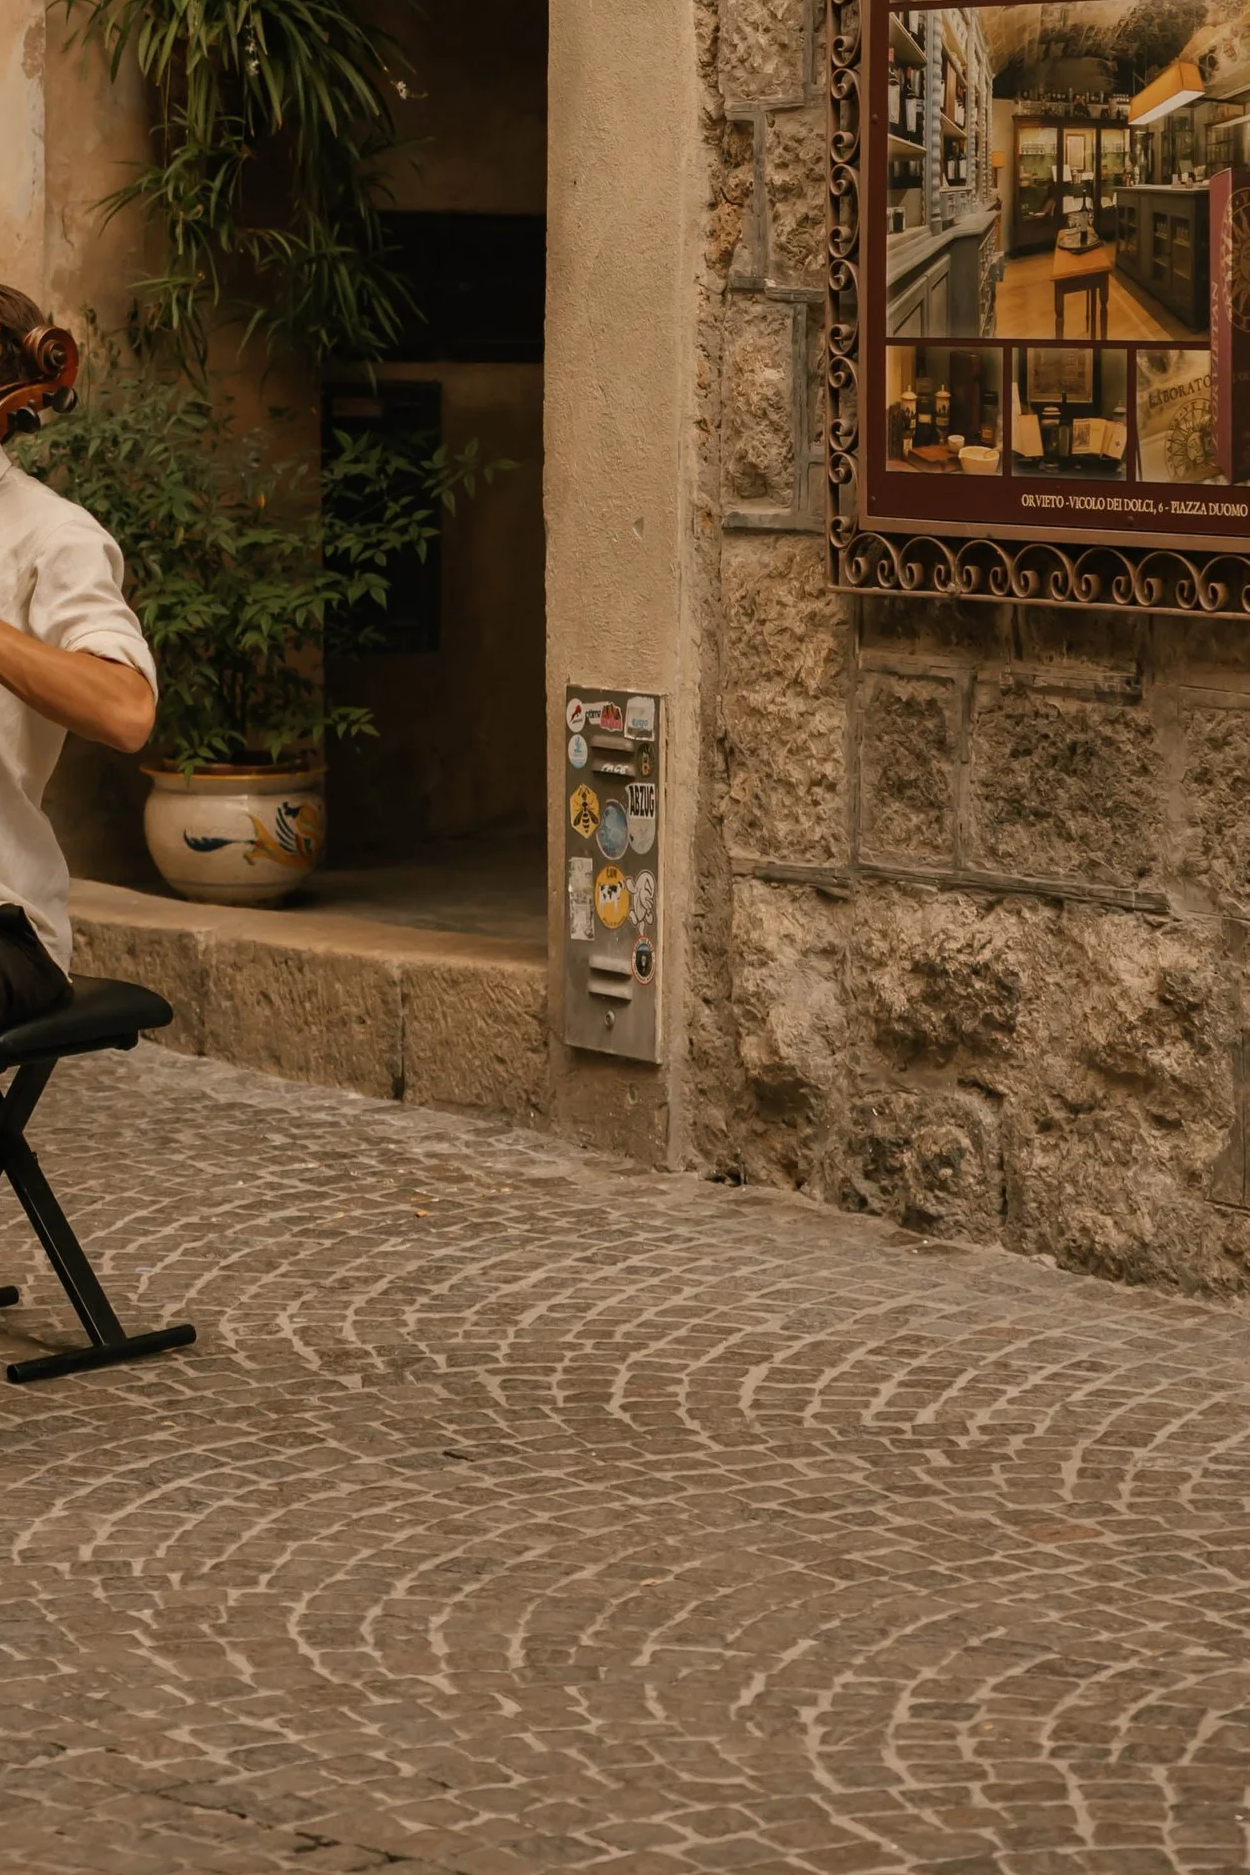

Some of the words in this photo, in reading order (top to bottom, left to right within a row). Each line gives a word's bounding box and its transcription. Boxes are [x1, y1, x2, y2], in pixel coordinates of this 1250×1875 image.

[1021, 494, 1065, 508] ORVIETO
[1106, 498, 1123, 511] DEI
[1123, 499, 1157, 515] DOLCI,
[1158, 502, 1164, 513] 6
[1170, 501, 1207, 515] PIAZZA
[1208, 504, 1249, 517] DUOMO
